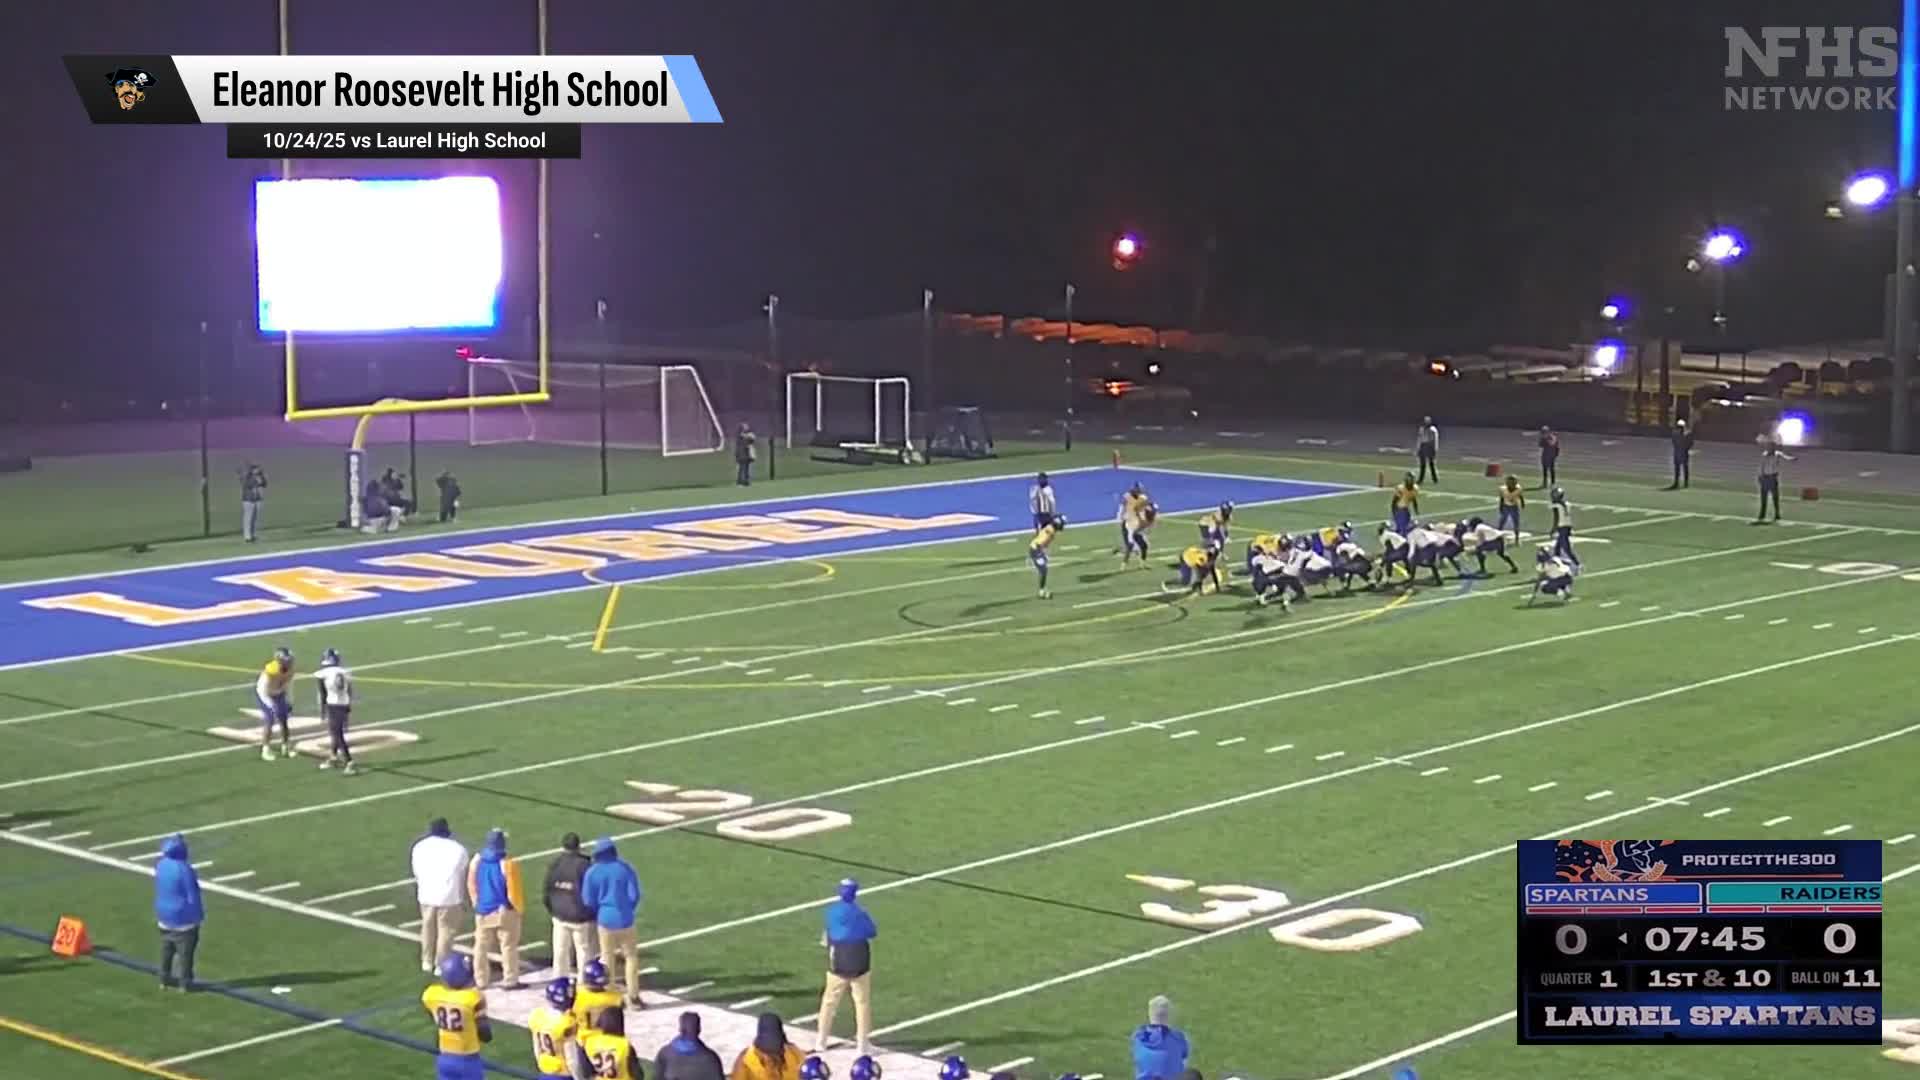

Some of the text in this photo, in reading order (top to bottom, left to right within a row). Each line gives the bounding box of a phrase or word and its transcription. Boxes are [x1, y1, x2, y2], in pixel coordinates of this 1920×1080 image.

[20, 509, 1000, 627] LAUREL
[604, 788, 852, 841] 20
[1139, 883, 1423, 952] 30
[436, 1006, 463, 1033] 82
